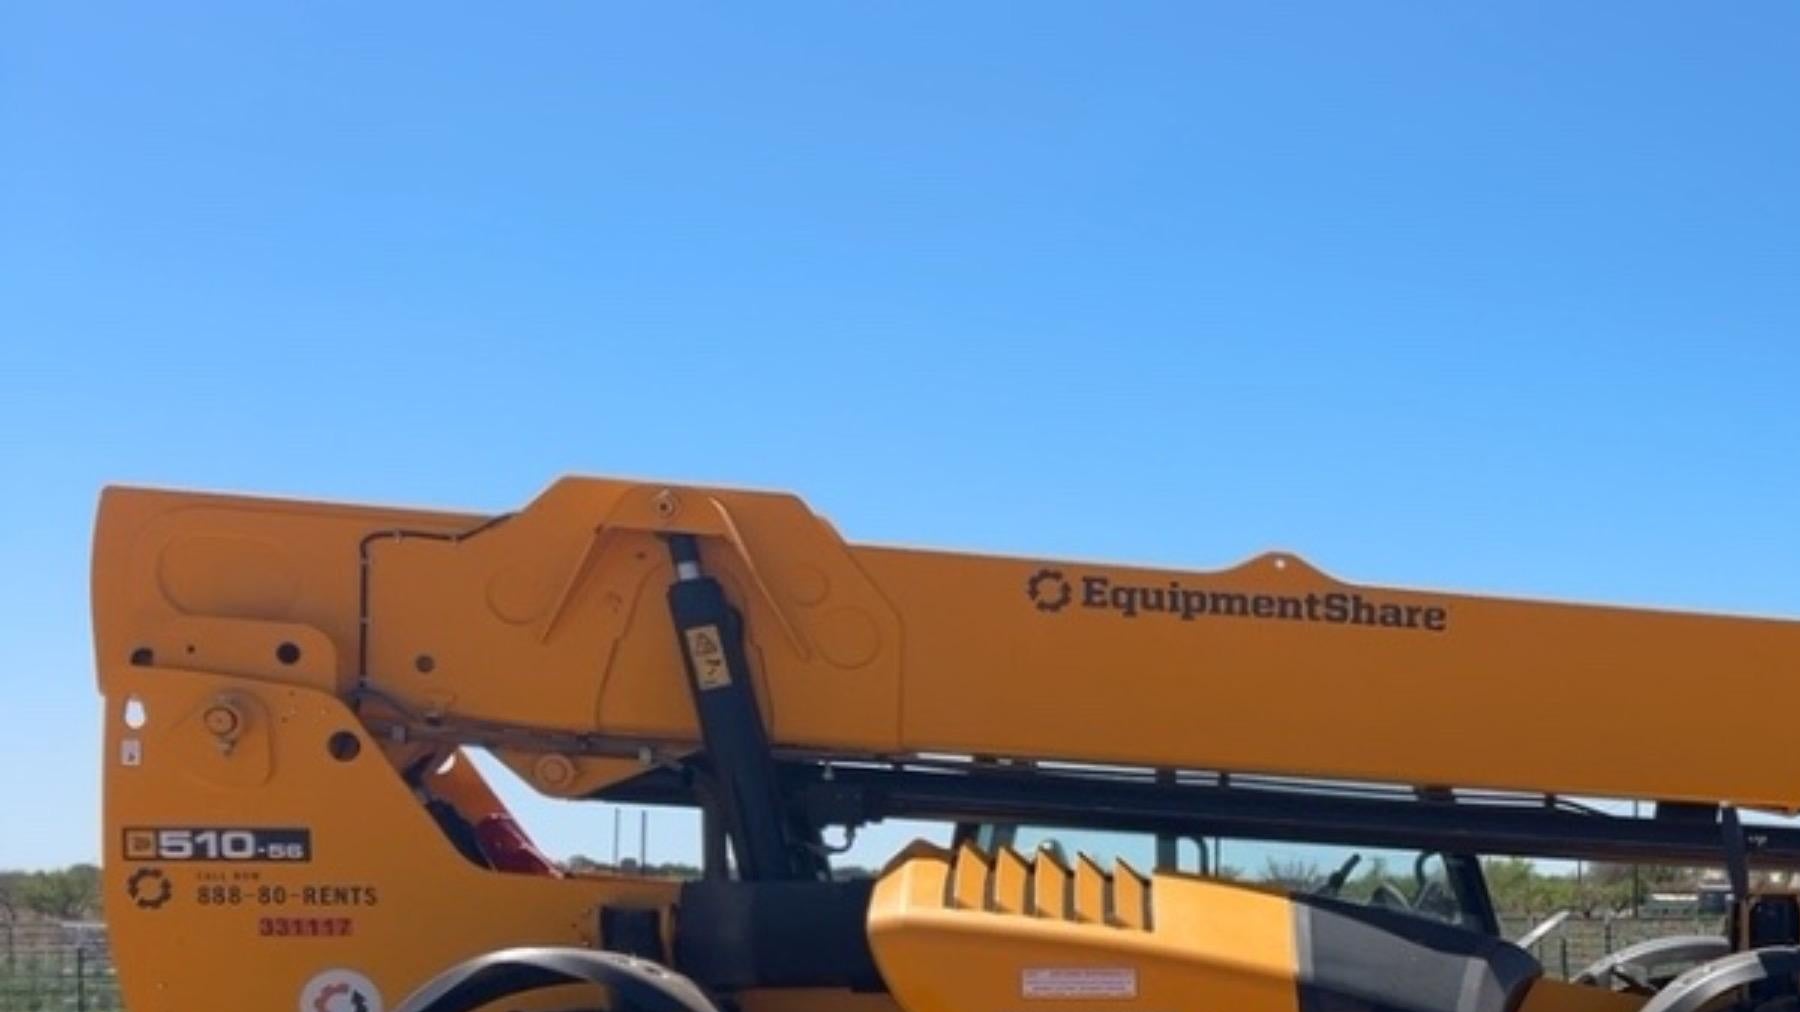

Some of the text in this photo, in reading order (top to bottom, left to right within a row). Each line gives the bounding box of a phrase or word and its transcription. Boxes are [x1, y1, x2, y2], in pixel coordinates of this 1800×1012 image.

[1081, 575, 1447, 632] EquipmentShare
[197, 885, 378, 906] 888-80-RENTS
[259, 917, 352, 936] 331117
